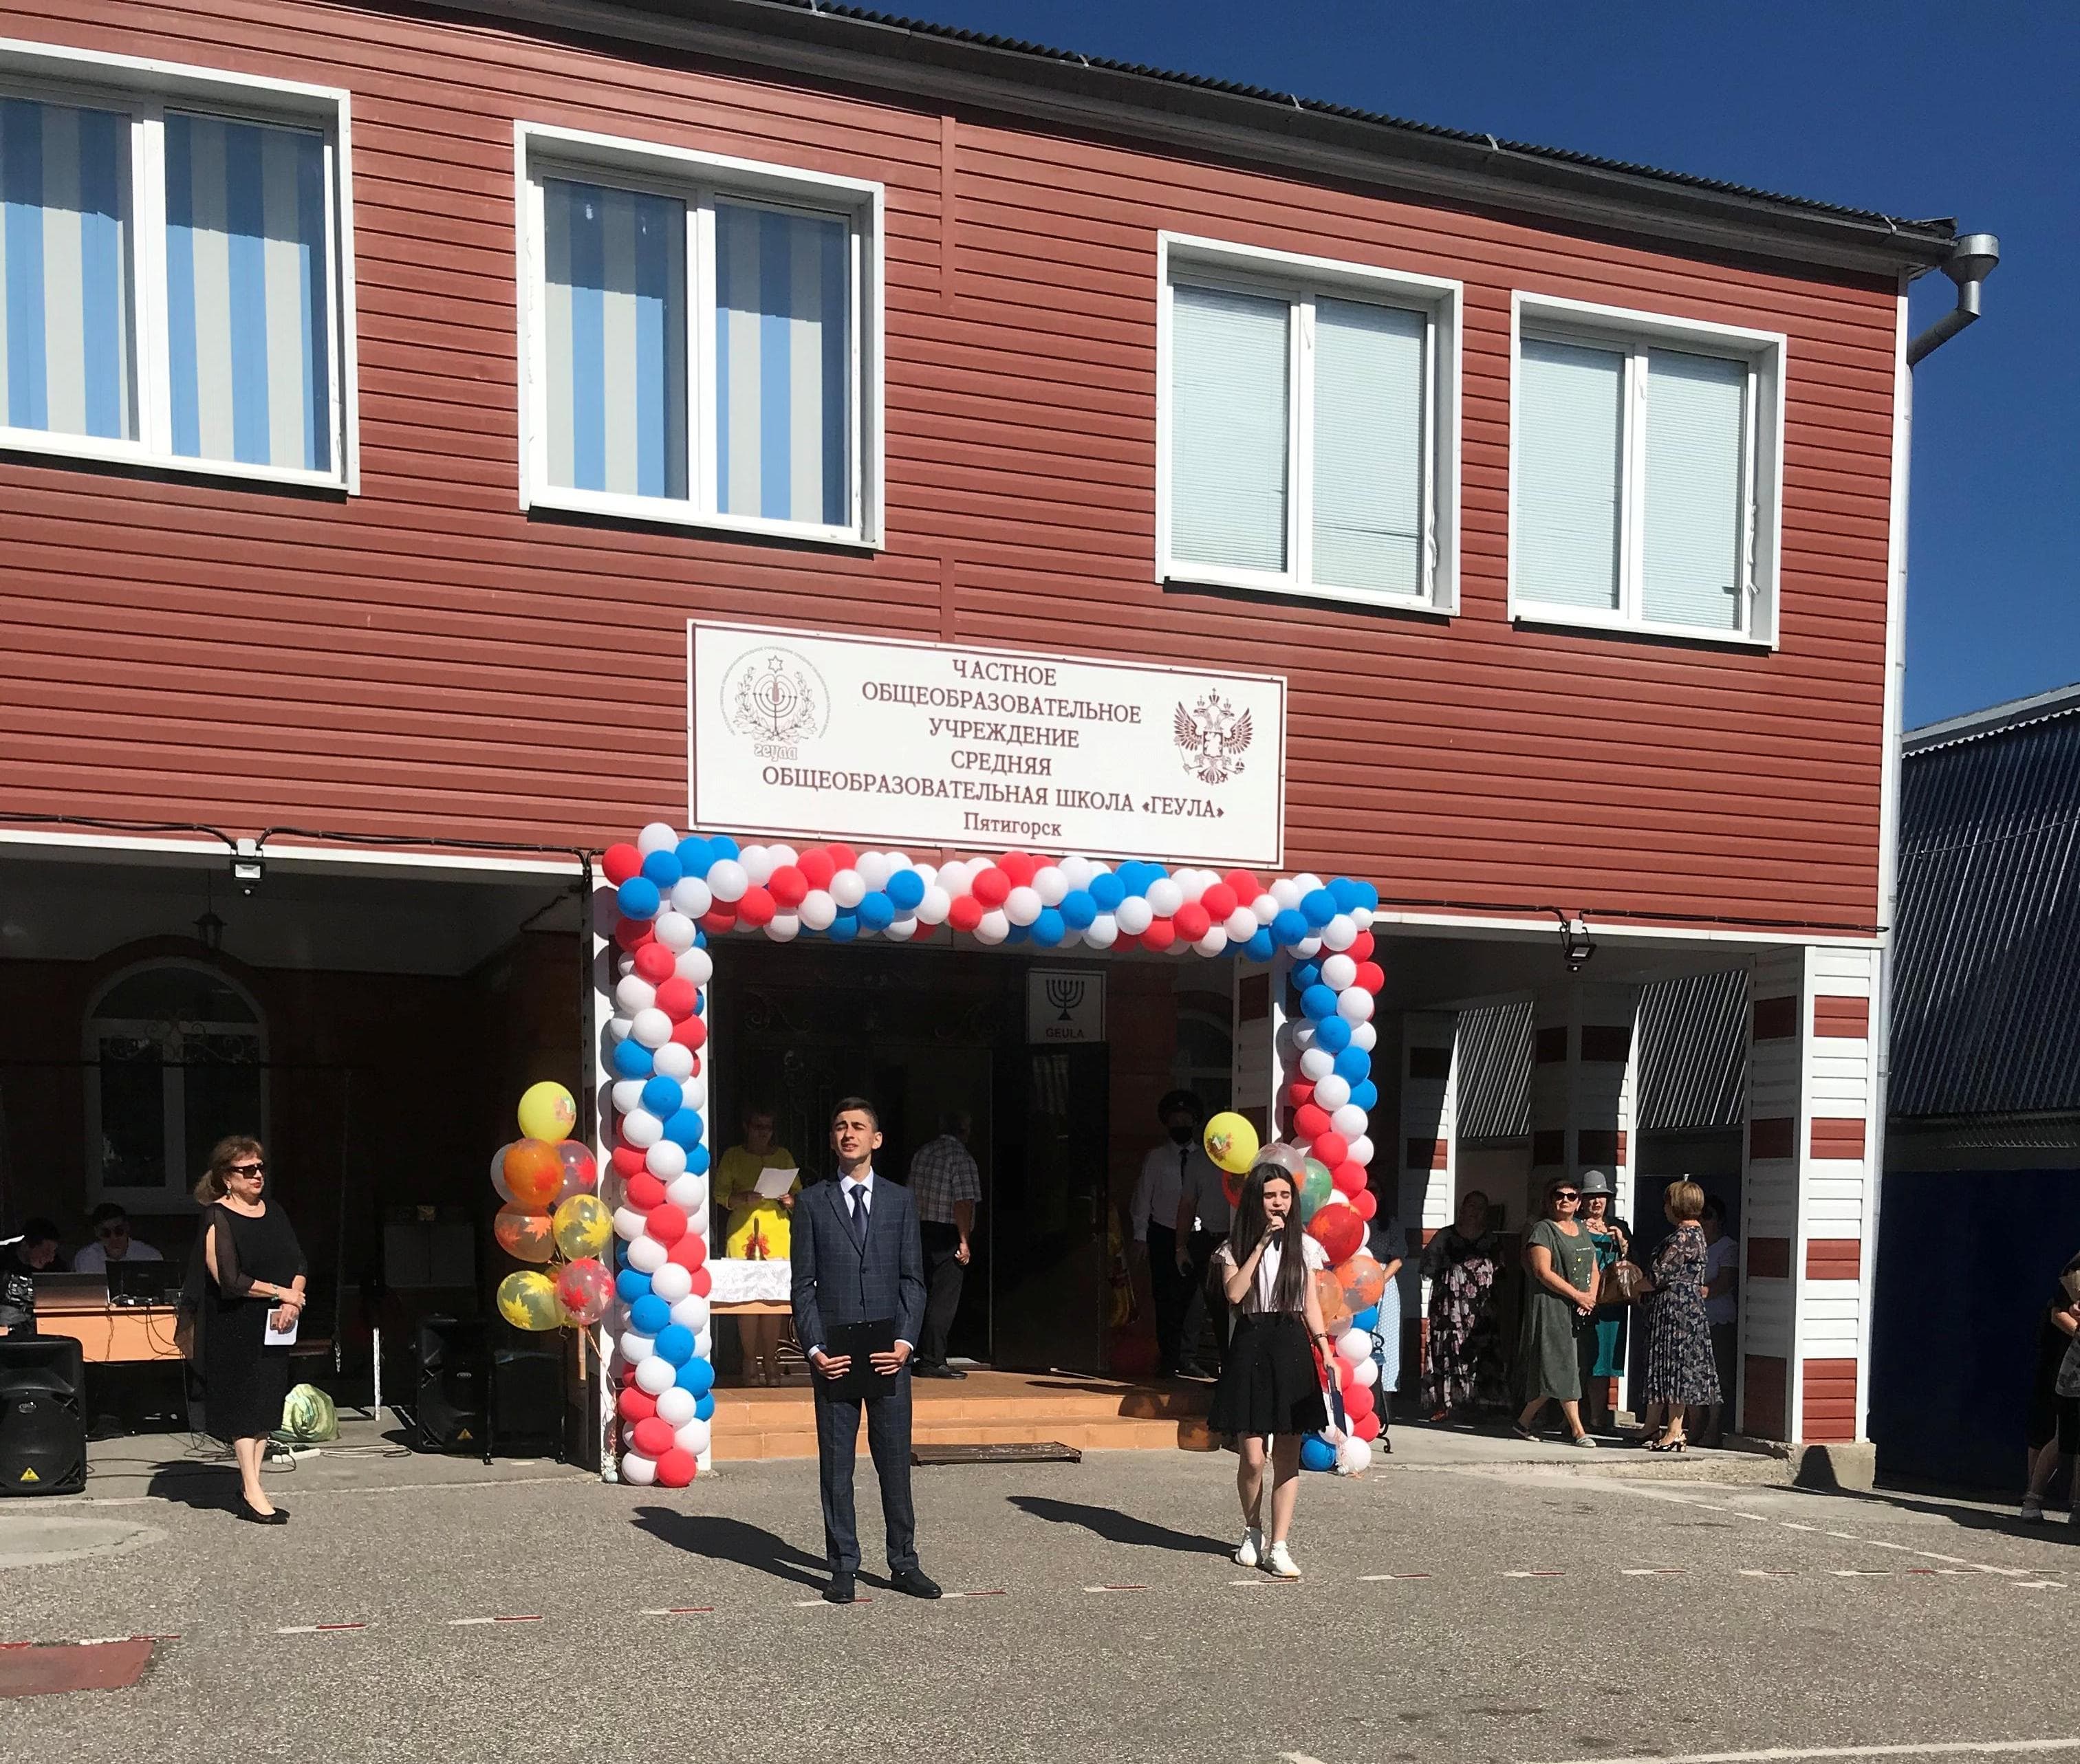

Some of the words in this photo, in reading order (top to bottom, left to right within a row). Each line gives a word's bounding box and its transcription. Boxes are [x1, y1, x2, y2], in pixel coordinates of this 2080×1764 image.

[953, 660, 1056, 686] ЧАСТНОЕ
[863, 682, 1141, 723] ОБЩЕОБРАЗОВАТЕЛЬНОЕ
[929, 718, 1079, 748] УЧРЕЖДЕНИЕ
[951, 750, 1051, 776] СРЕДНЯЯ
[763, 766, 1048, 805] ОБЩЕОБРАЗОВАТЕЛЬНАЯ
[1057, 789, 1134, 812] ШКОЛА
[1142, 796, 1224, 818] «ГЕУЛА»
[964, 812, 1061, 839] Пятигорск
[1046, 1027, 1085, 1039] GEULA
